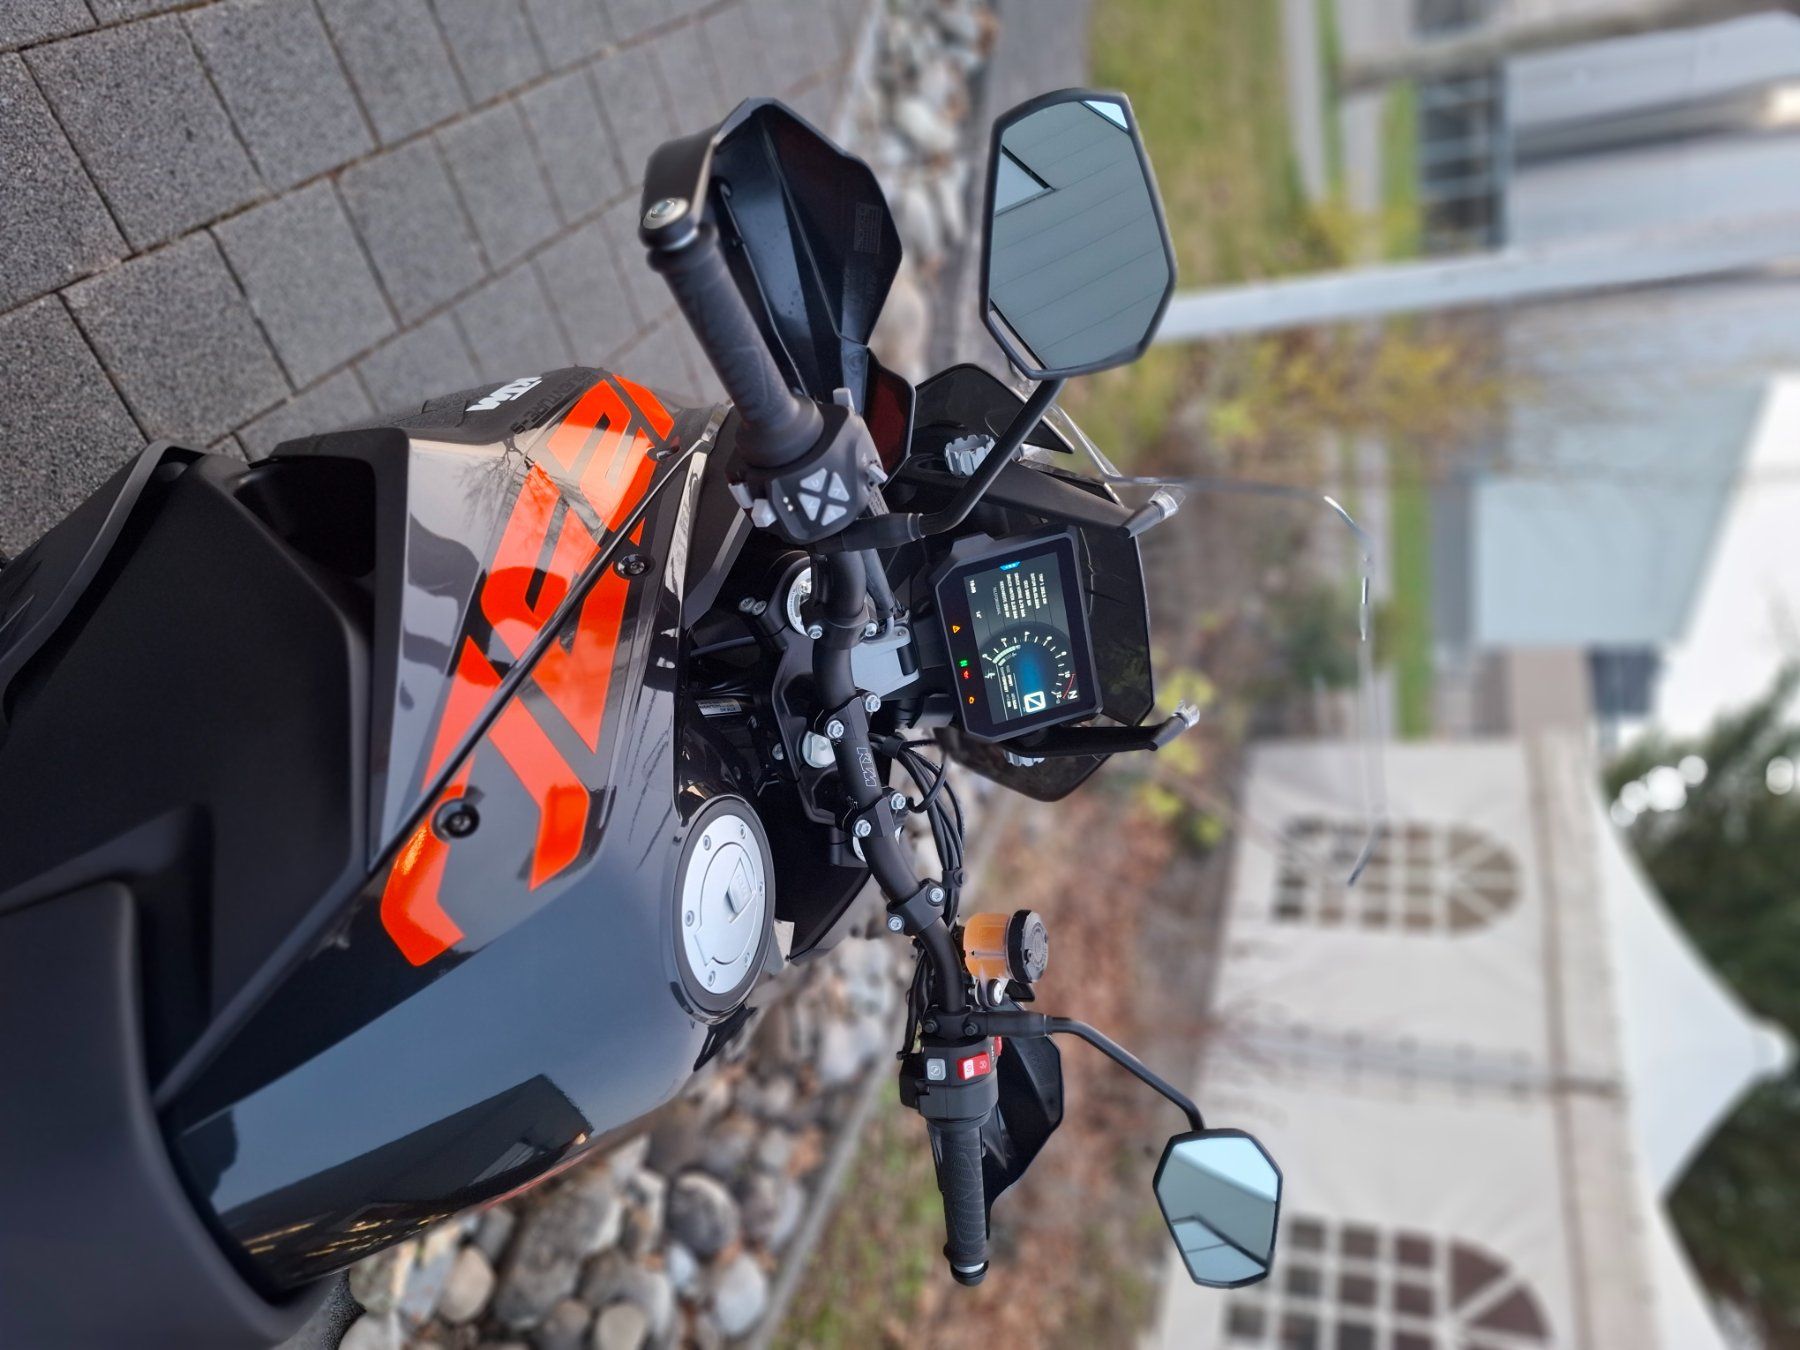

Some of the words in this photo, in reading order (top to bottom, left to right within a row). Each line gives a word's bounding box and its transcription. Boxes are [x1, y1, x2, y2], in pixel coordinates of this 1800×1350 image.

[466, 377, 543, 412] KTM
[1068, 690, 1078, 699] N
[857, 747, 877, 787] KTM
